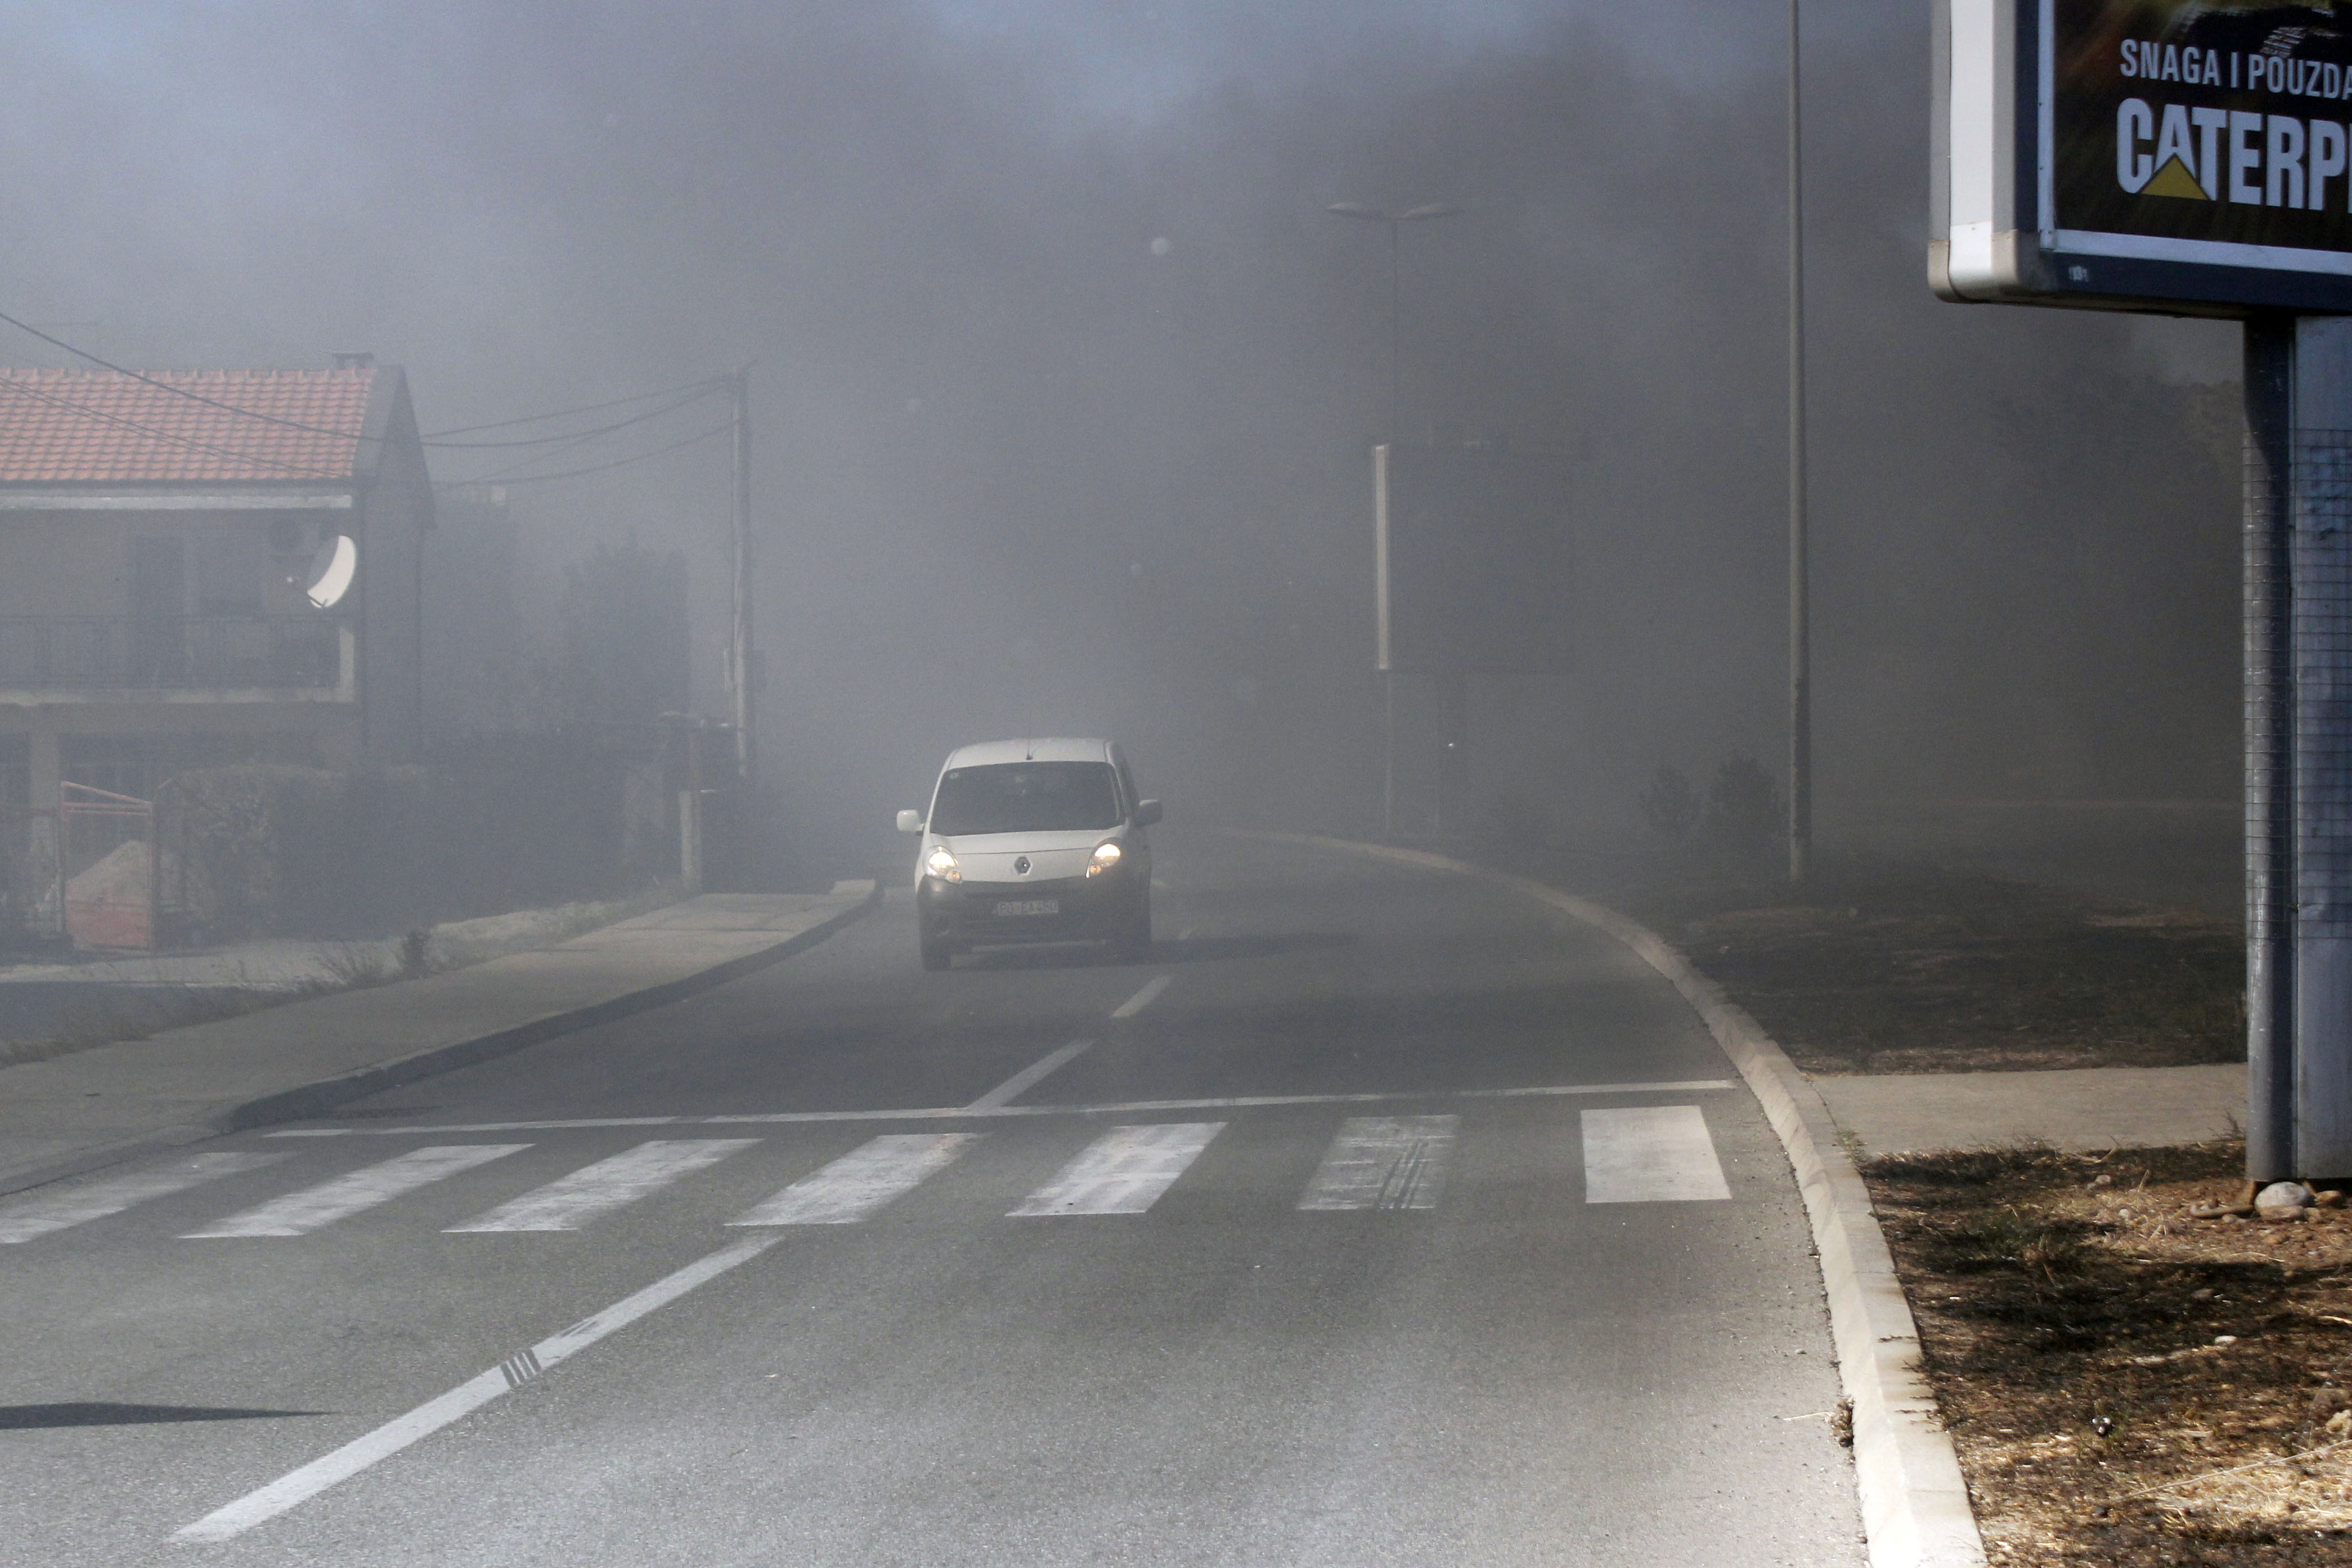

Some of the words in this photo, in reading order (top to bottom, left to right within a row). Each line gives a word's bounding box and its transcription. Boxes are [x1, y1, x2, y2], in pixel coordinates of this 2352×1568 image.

[2120, 39, 2220, 86] SNAGA
[2230, 52, 2238, 88] I
[2116, 98, 2352, 214] CATERP
